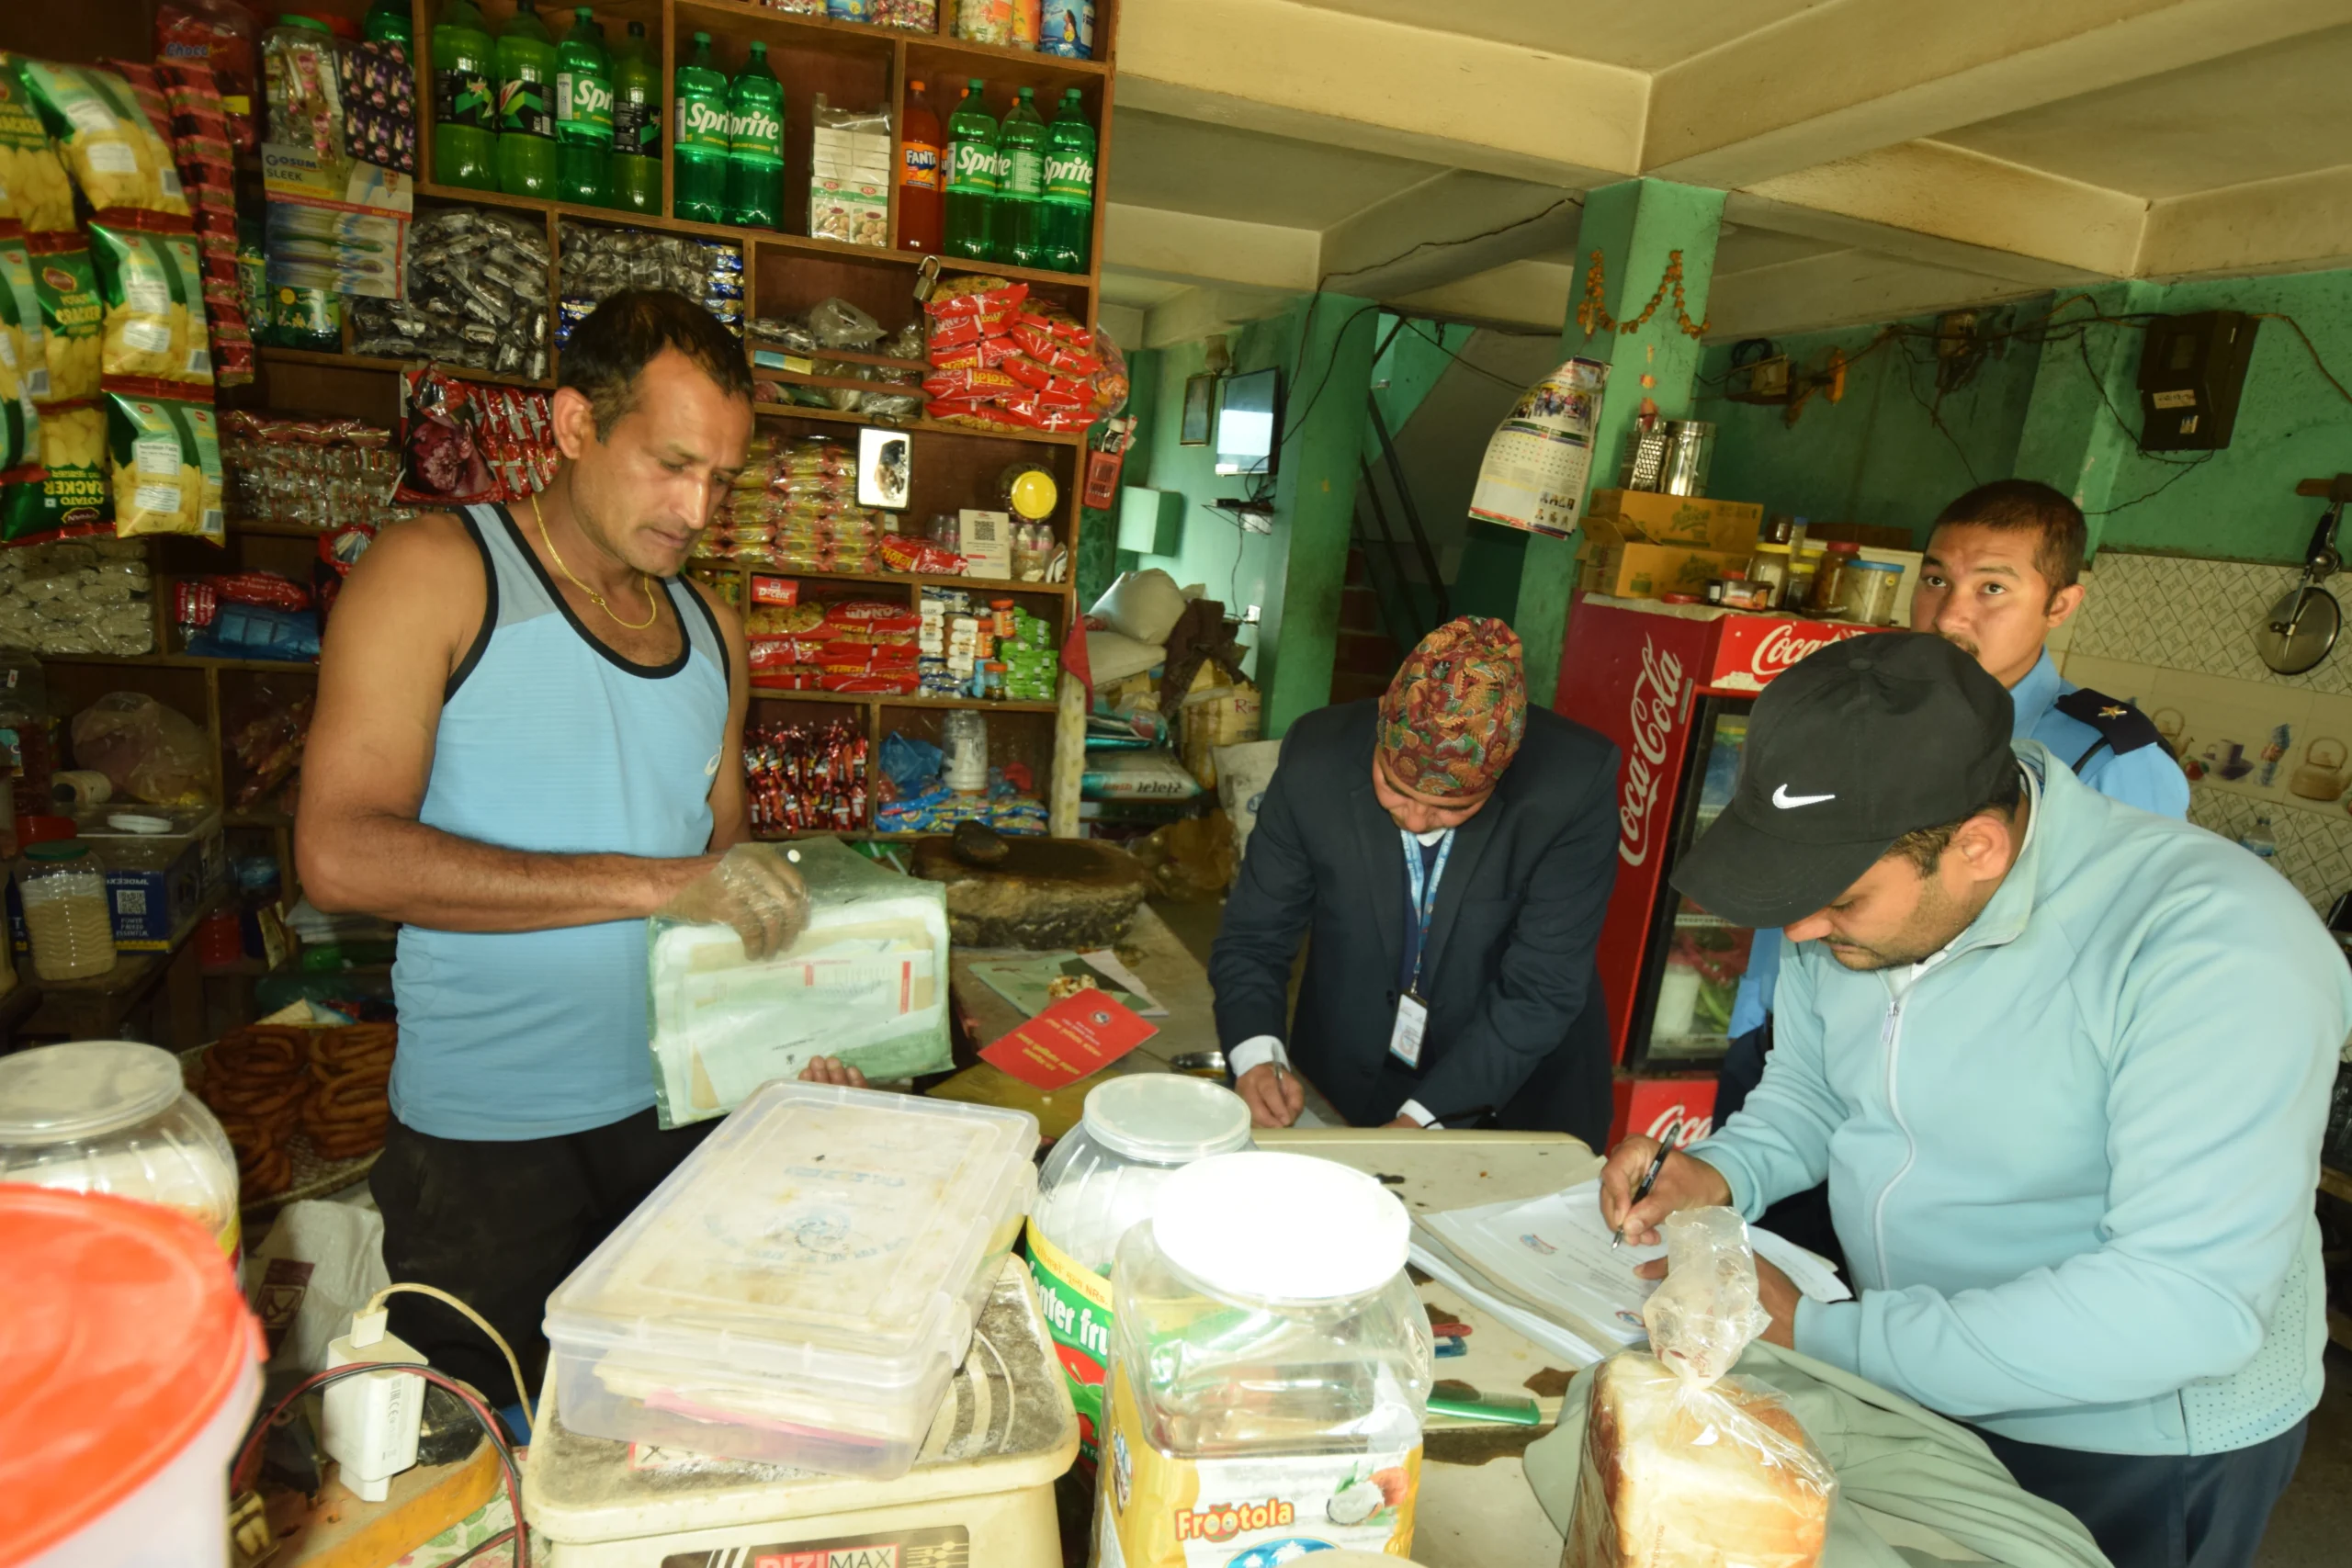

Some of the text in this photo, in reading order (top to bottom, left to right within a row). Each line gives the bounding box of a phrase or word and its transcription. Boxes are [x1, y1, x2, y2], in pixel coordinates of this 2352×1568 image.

[730, 110, 779, 140] prite
[266, 169, 303, 182] SLEEK
[1044, 156, 1093, 185] Sprite
[43, 480, 105, 494] RACKER
[60, 496, 104, 505] POTATO
[1029, 1260, 1110, 1356] enter fru
[1175, 1497, 1295, 1542] Frootola
